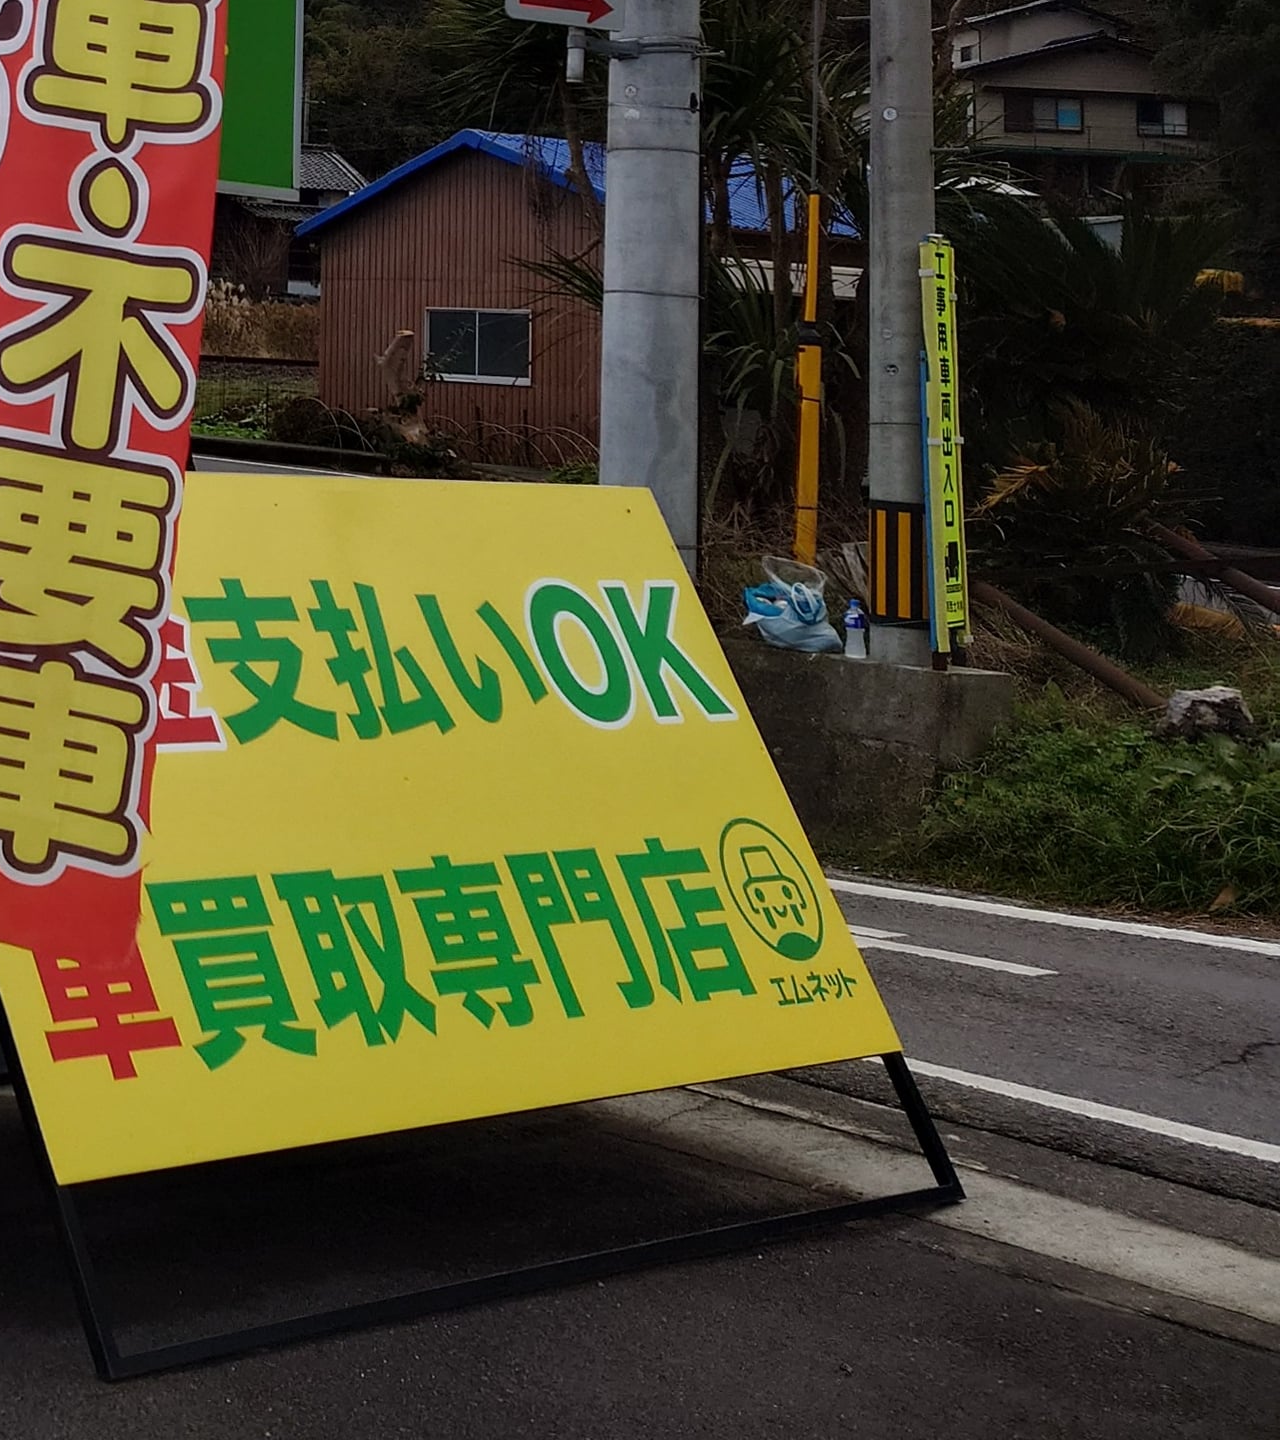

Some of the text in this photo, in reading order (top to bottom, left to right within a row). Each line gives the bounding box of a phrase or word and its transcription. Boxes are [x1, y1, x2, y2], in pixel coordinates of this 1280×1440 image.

[769, 968, 857, 1006] エムネット
